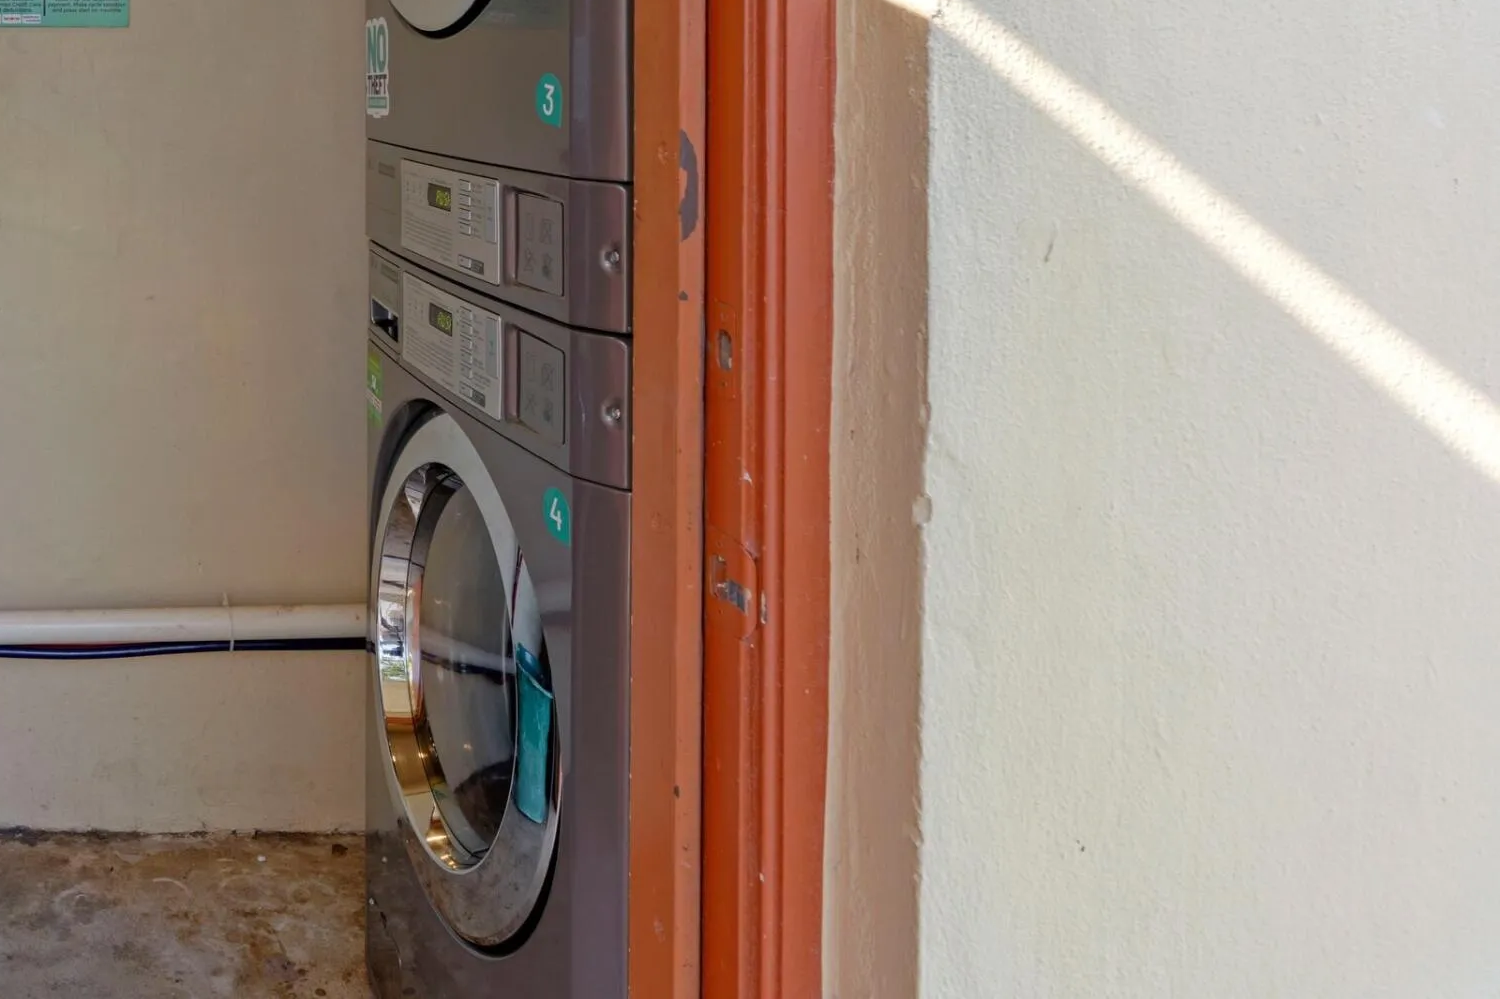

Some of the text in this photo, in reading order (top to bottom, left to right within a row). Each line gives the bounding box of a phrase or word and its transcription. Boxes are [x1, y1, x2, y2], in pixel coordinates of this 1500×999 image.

[367, 23, 388, 74] NO
[542, 83, 555, 117] 3
[549, 497, 563, 531] 4
